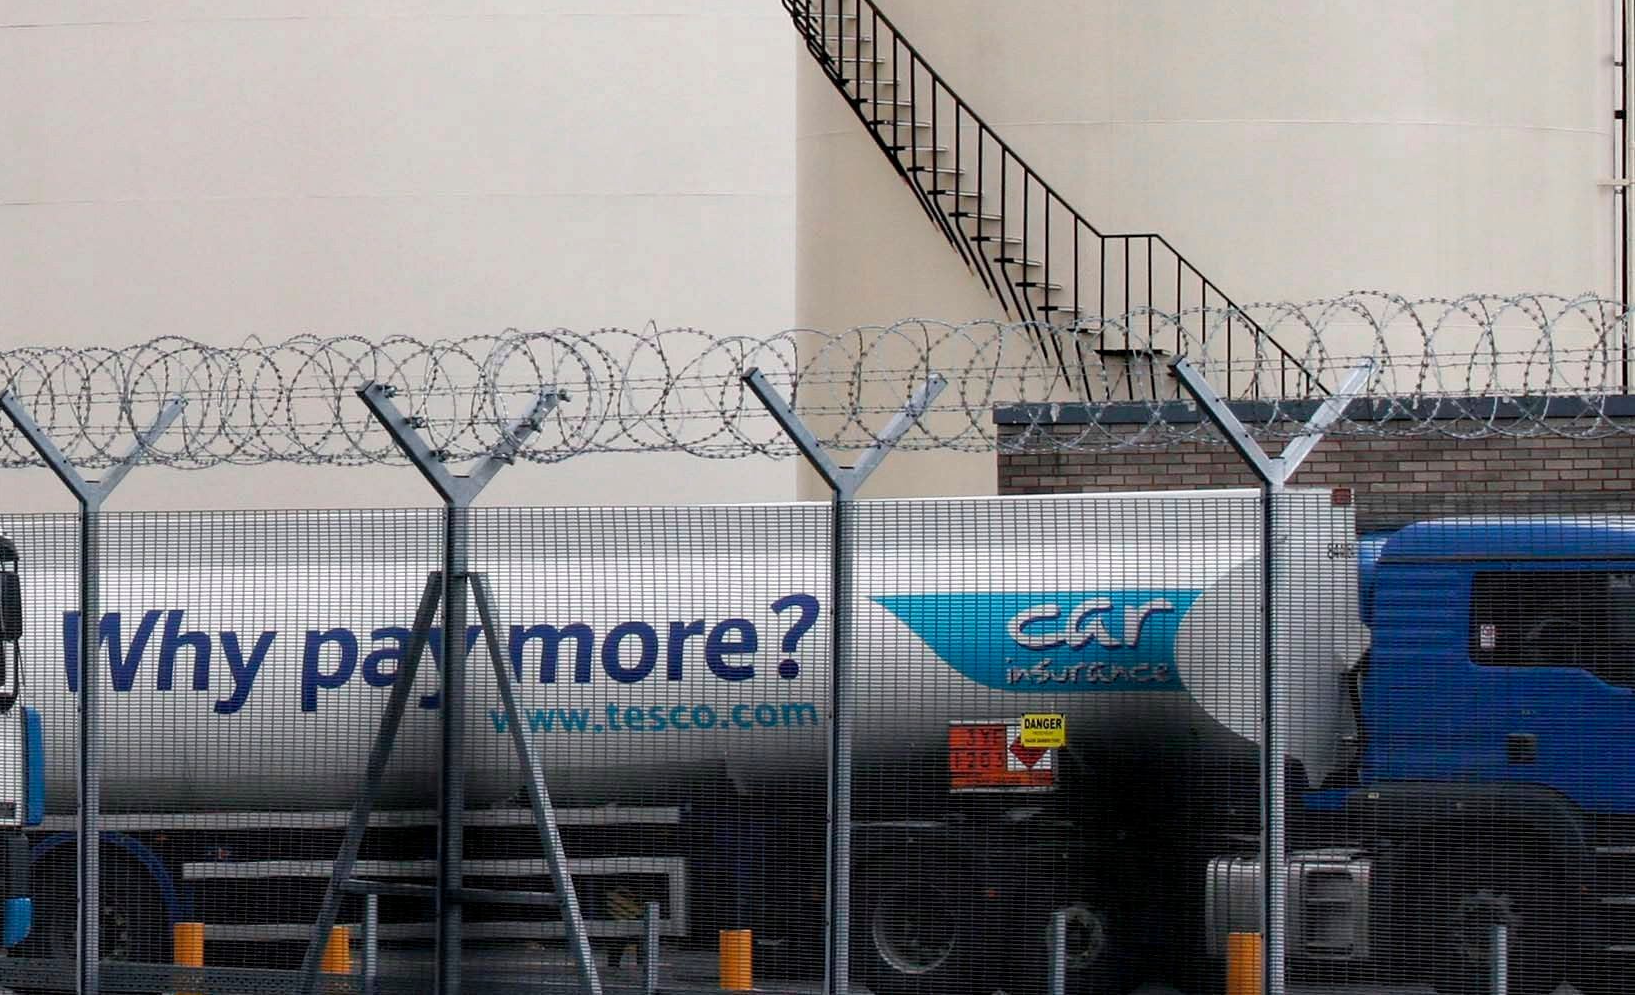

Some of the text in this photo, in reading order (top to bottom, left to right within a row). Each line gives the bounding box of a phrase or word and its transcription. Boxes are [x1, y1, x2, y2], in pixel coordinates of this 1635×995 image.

[1007, 597, 1175, 649] car
[63, 609, 274, 714] Why
[509, 593, 820, 684] more?
[1005, 658, 1174, 684] insurance
[490, 702, 819, 733] www.tesco.com
[1025, 718, 1062, 729] DANGER
